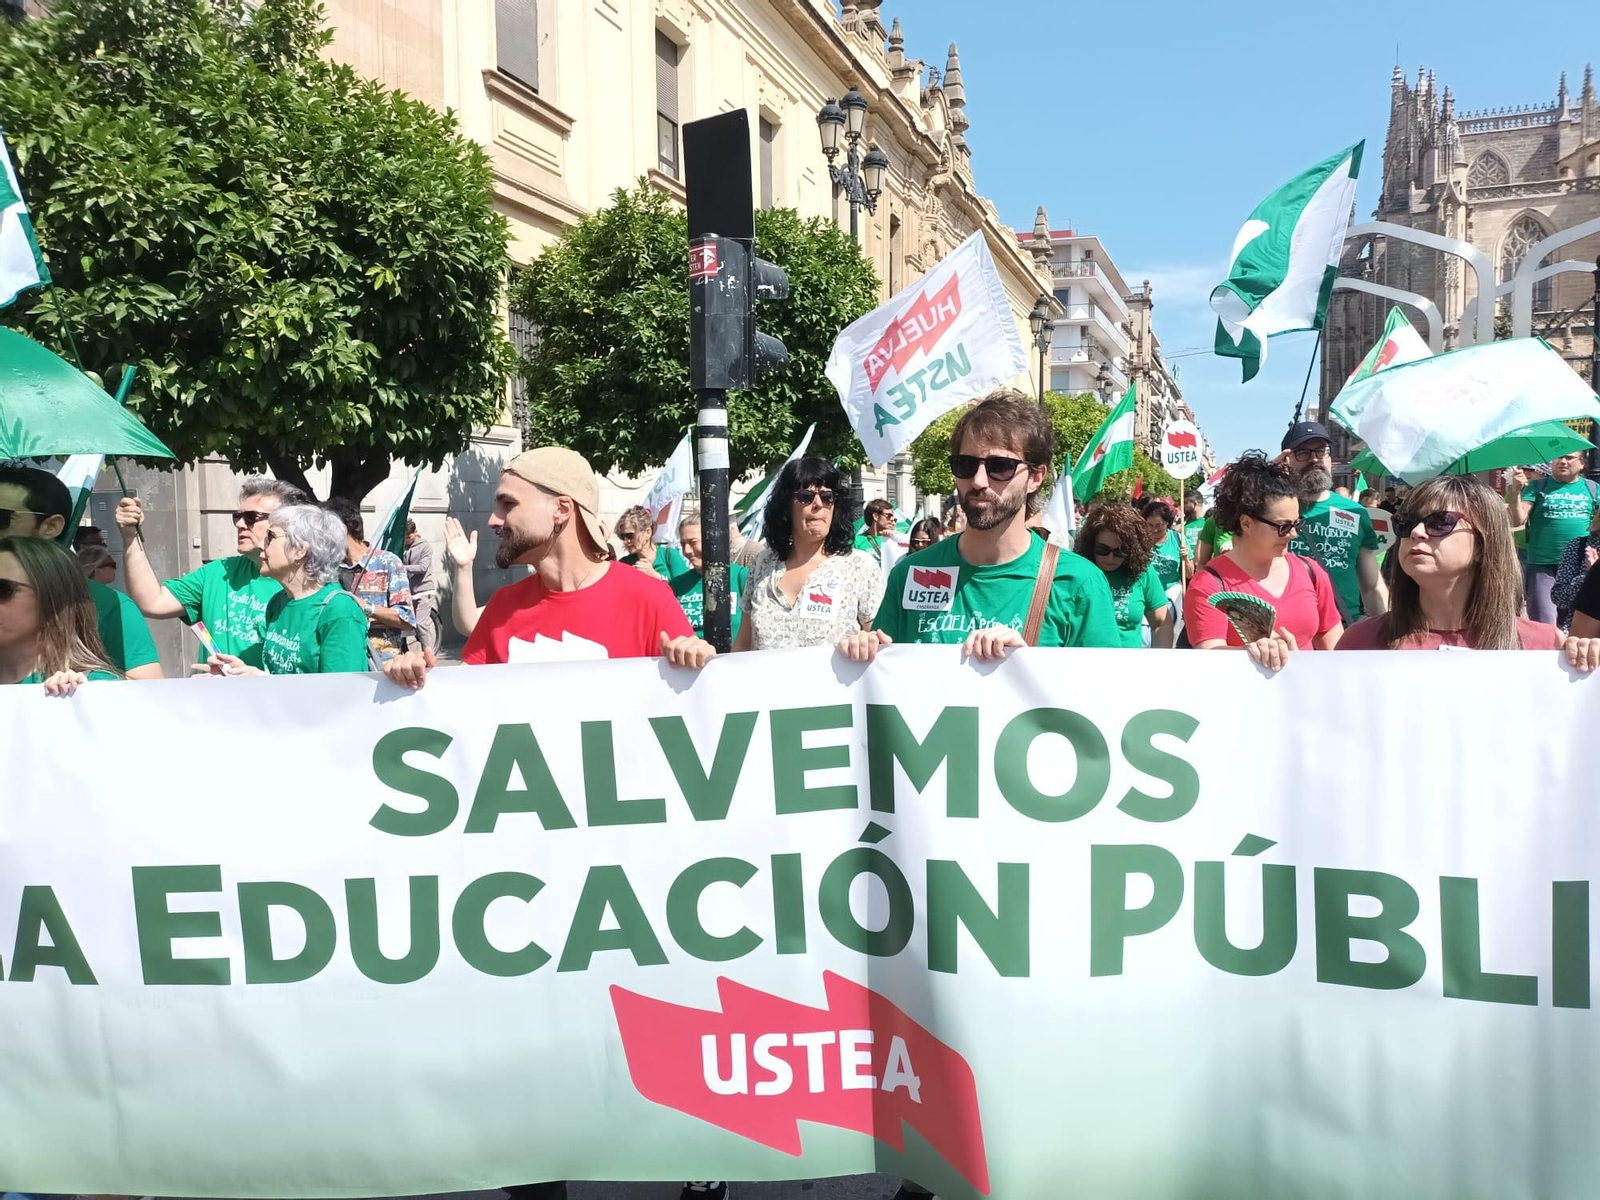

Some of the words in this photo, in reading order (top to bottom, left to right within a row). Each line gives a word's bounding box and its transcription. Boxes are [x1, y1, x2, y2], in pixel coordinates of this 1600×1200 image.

[1167, 451, 1197, 464] USTEA
[1335, 518, 1355, 529] USTEA
[908, 589, 950, 604] USTEA
[806, 603, 832, 614] USTEA
[368, 703, 1200, 837] SALVEMOS
[0, 884, 99, 986] A
[131, 821, 1031, 986] EDUCACIÓN
[1090, 833, 1591, 1009] PÚBLI
[702, 1028, 922, 1104] USTEA
